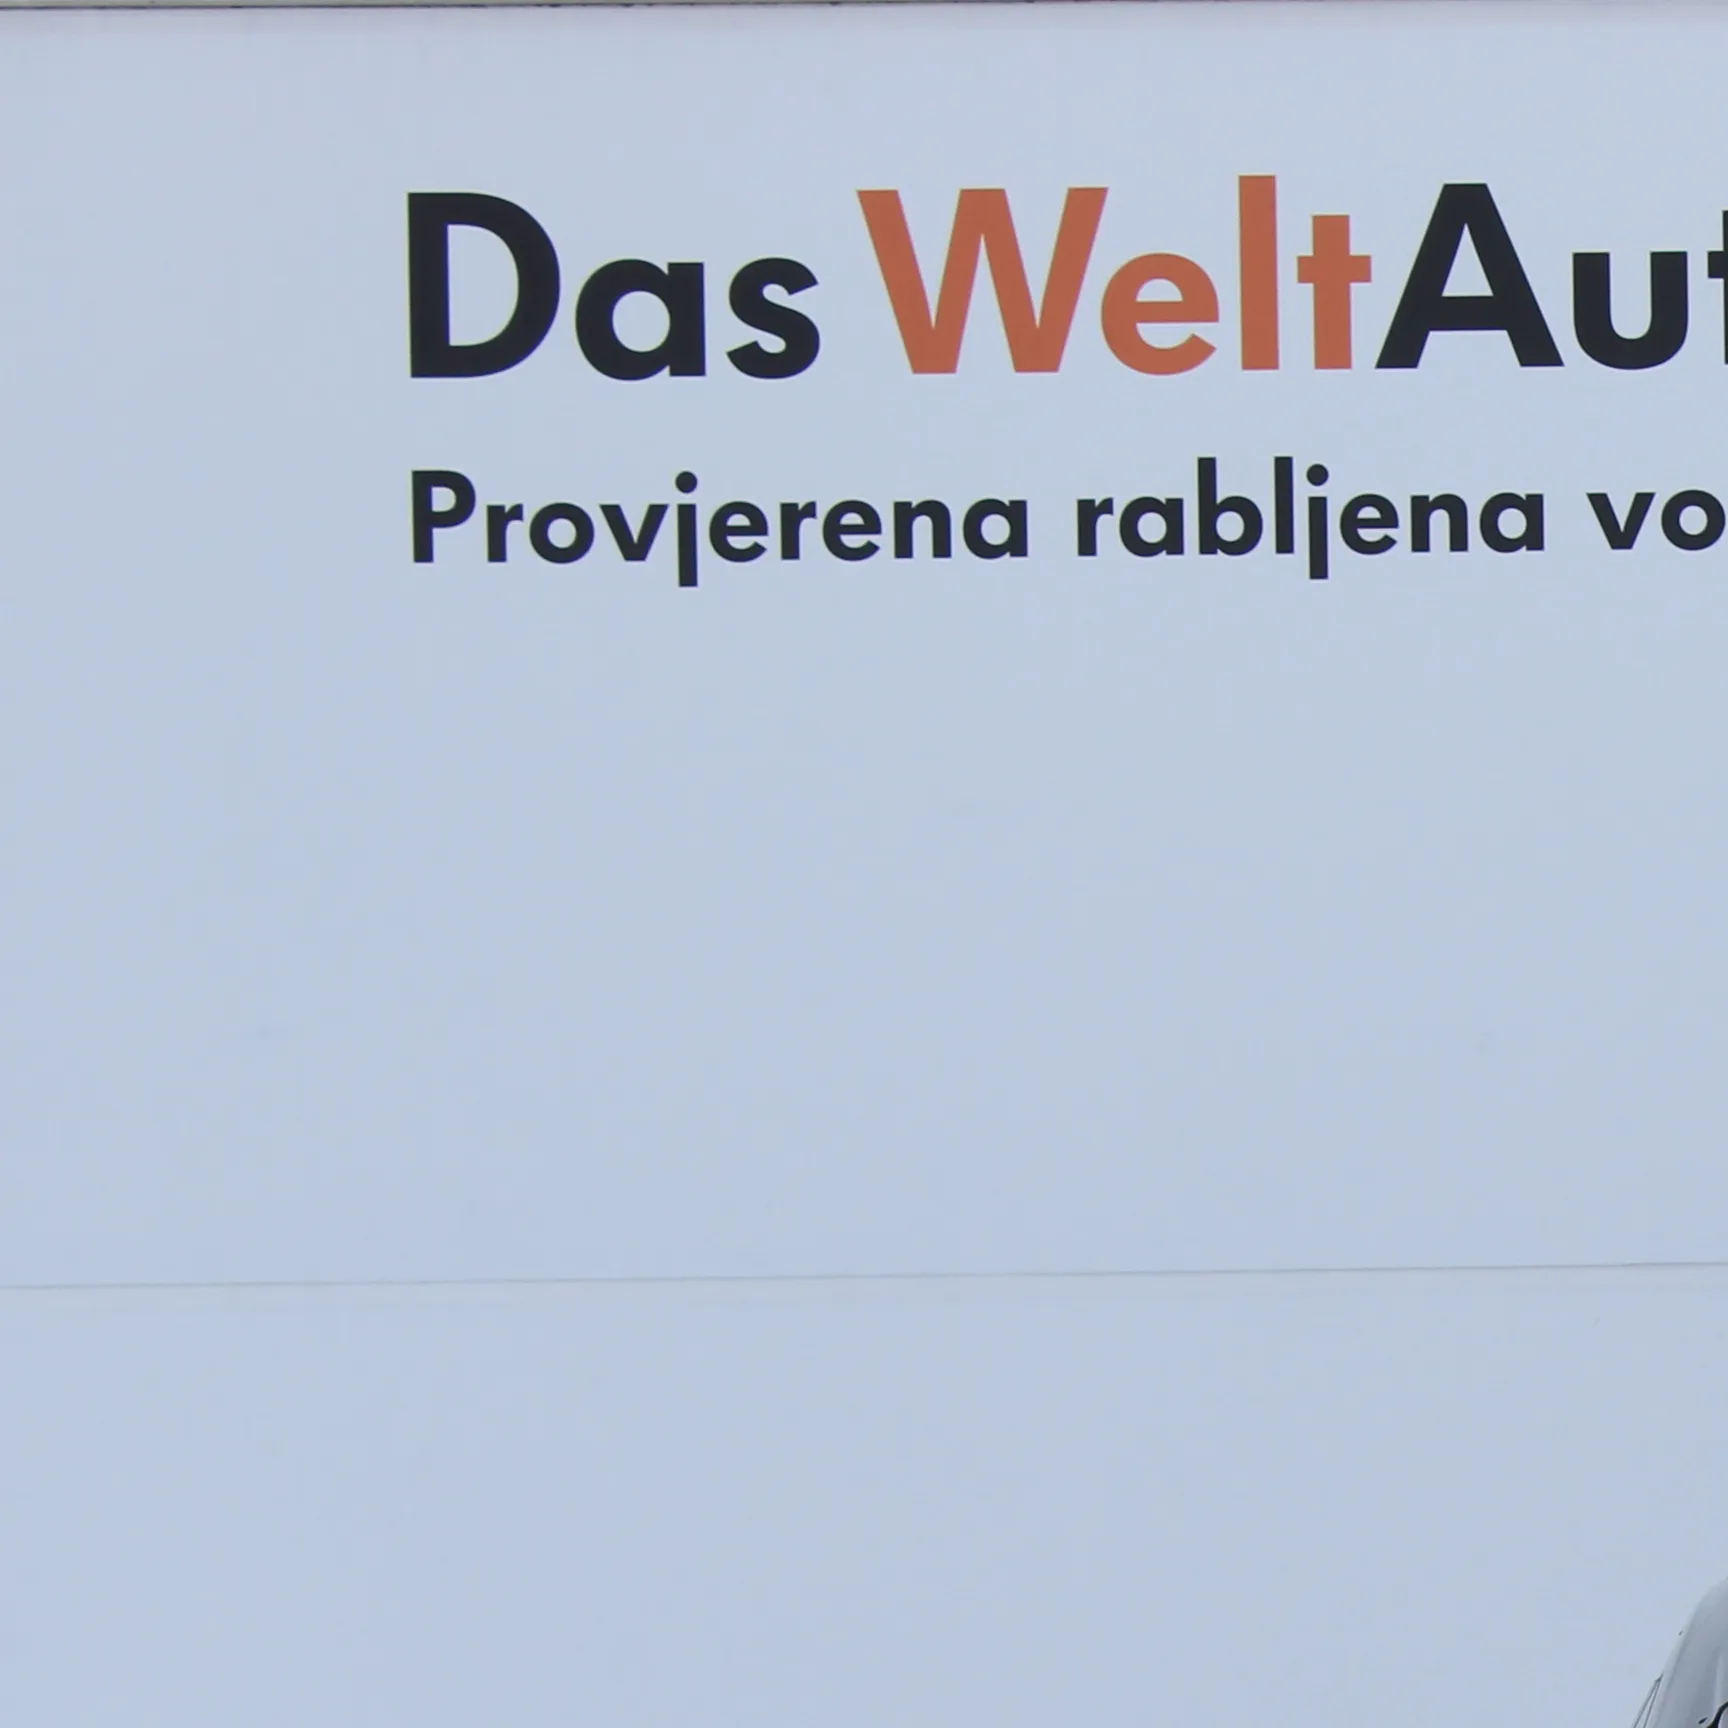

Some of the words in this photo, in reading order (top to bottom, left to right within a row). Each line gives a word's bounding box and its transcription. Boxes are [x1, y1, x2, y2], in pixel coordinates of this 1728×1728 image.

[408, 193, 821, 382] Das
[412, 470, 1029, 588] Provjerena
[1077, 456, 1546, 581] rabljena
